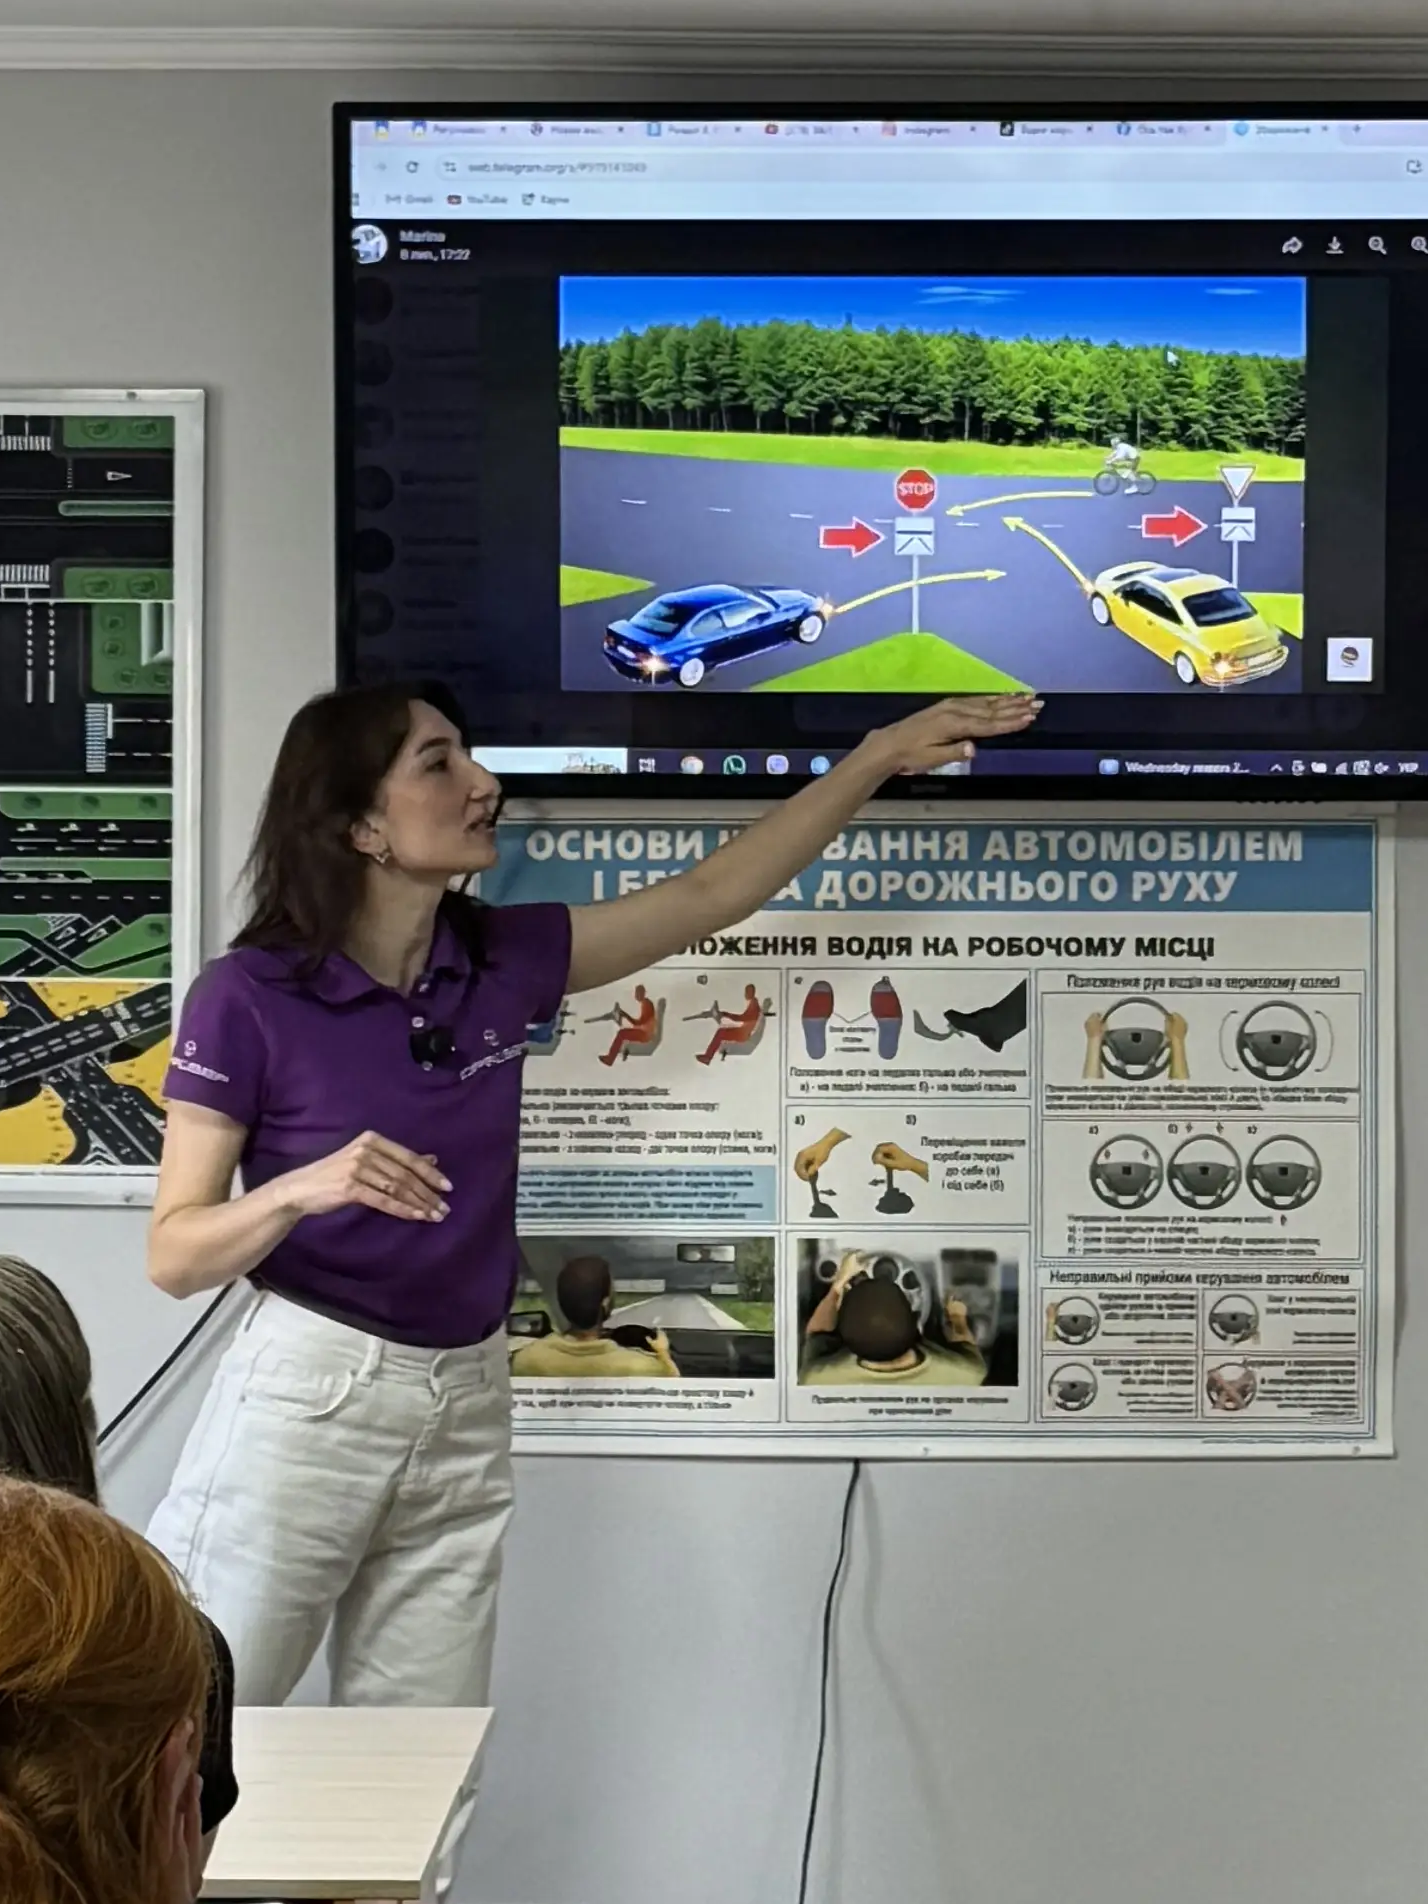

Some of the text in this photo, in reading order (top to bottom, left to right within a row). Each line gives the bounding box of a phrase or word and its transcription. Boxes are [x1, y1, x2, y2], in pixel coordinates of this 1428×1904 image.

[466, 192, 509, 205] YouTube
[897, 482, 934, 496] STOP
[1124, 761, 1191, 776] Wednesday
[525, 829, 704, 861] ОСНОВИ
[982, 829, 1303, 862] АВТОМОБІЛЕМ
[814, 870, 1118, 909] ДОРОЖНЬОГО
[1132, 871, 1238, 903] РУХУ
[827, 936, 912, 960] ВОДІЯ
[923, 936, 959, 957] НА
[968, 936, 1126, 958] РОБОЧОМУ
[1134, 936, 1215, 960] МІСЦІ
[1049, 1269, 1133, 1284] Неправильні
